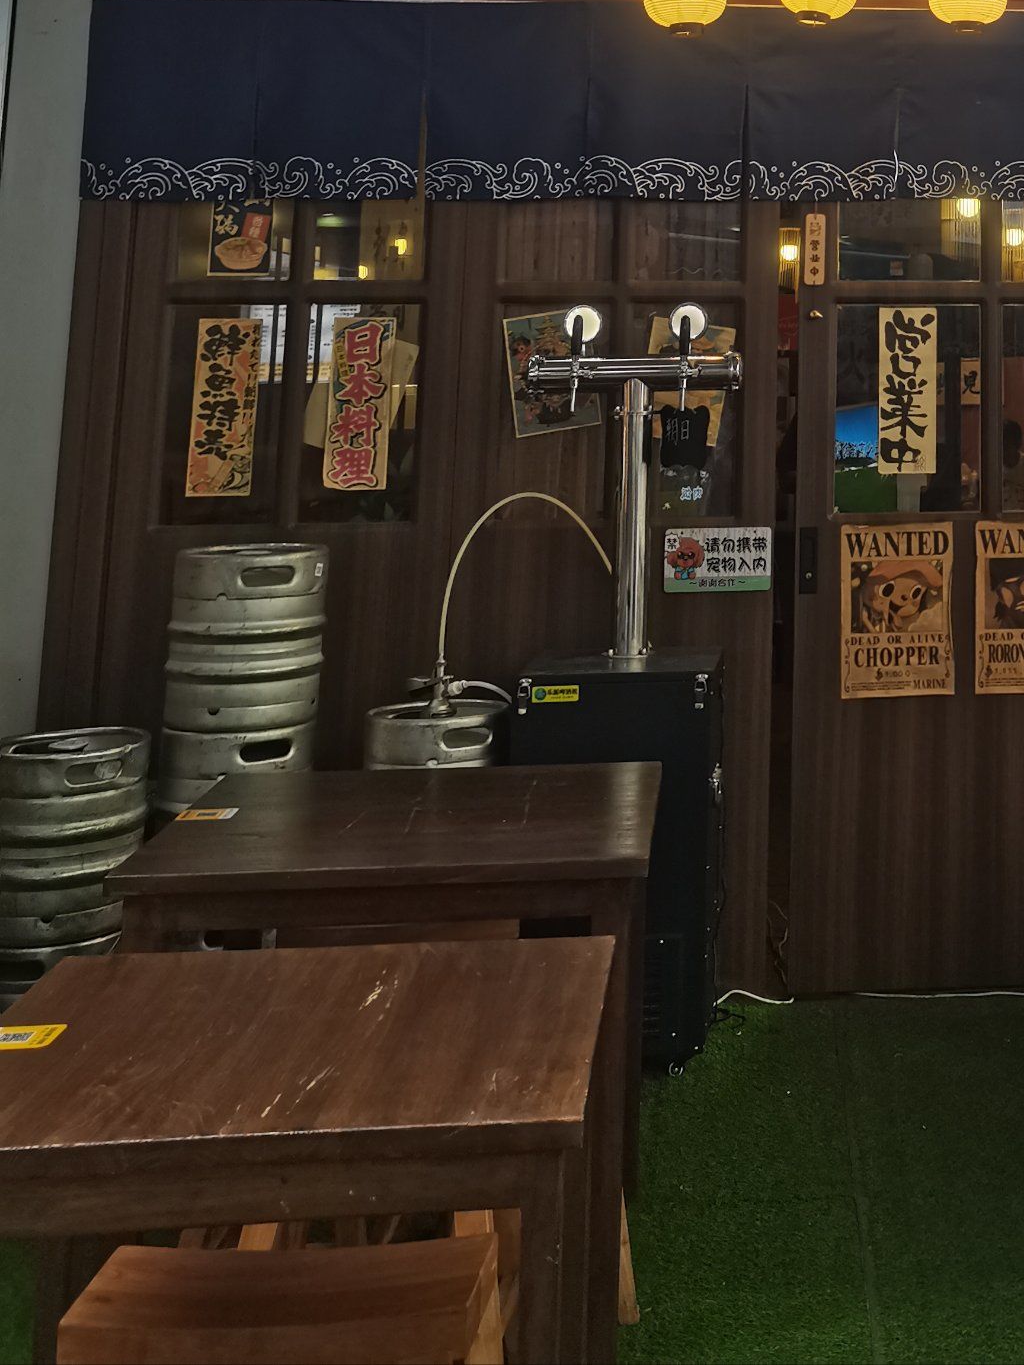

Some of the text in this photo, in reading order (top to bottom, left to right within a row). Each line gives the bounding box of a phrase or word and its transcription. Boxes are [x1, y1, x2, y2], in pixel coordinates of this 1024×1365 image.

[329, 321, 387, 488] 日本料理
[666, 537, 678, 550] 禁
[705, 537, 767, 554] 请勿携带
[846, 532, 949, 560] WANTED
[706, 557, 767, 573] 宠物入内
[850, 633, 944, 645] DEAD OR ALIVE
[985, 632, 1013, 641] DEAD
[854, 645, 939, 667] CHOPPER
[913, 679, 946, 690] MARINE
